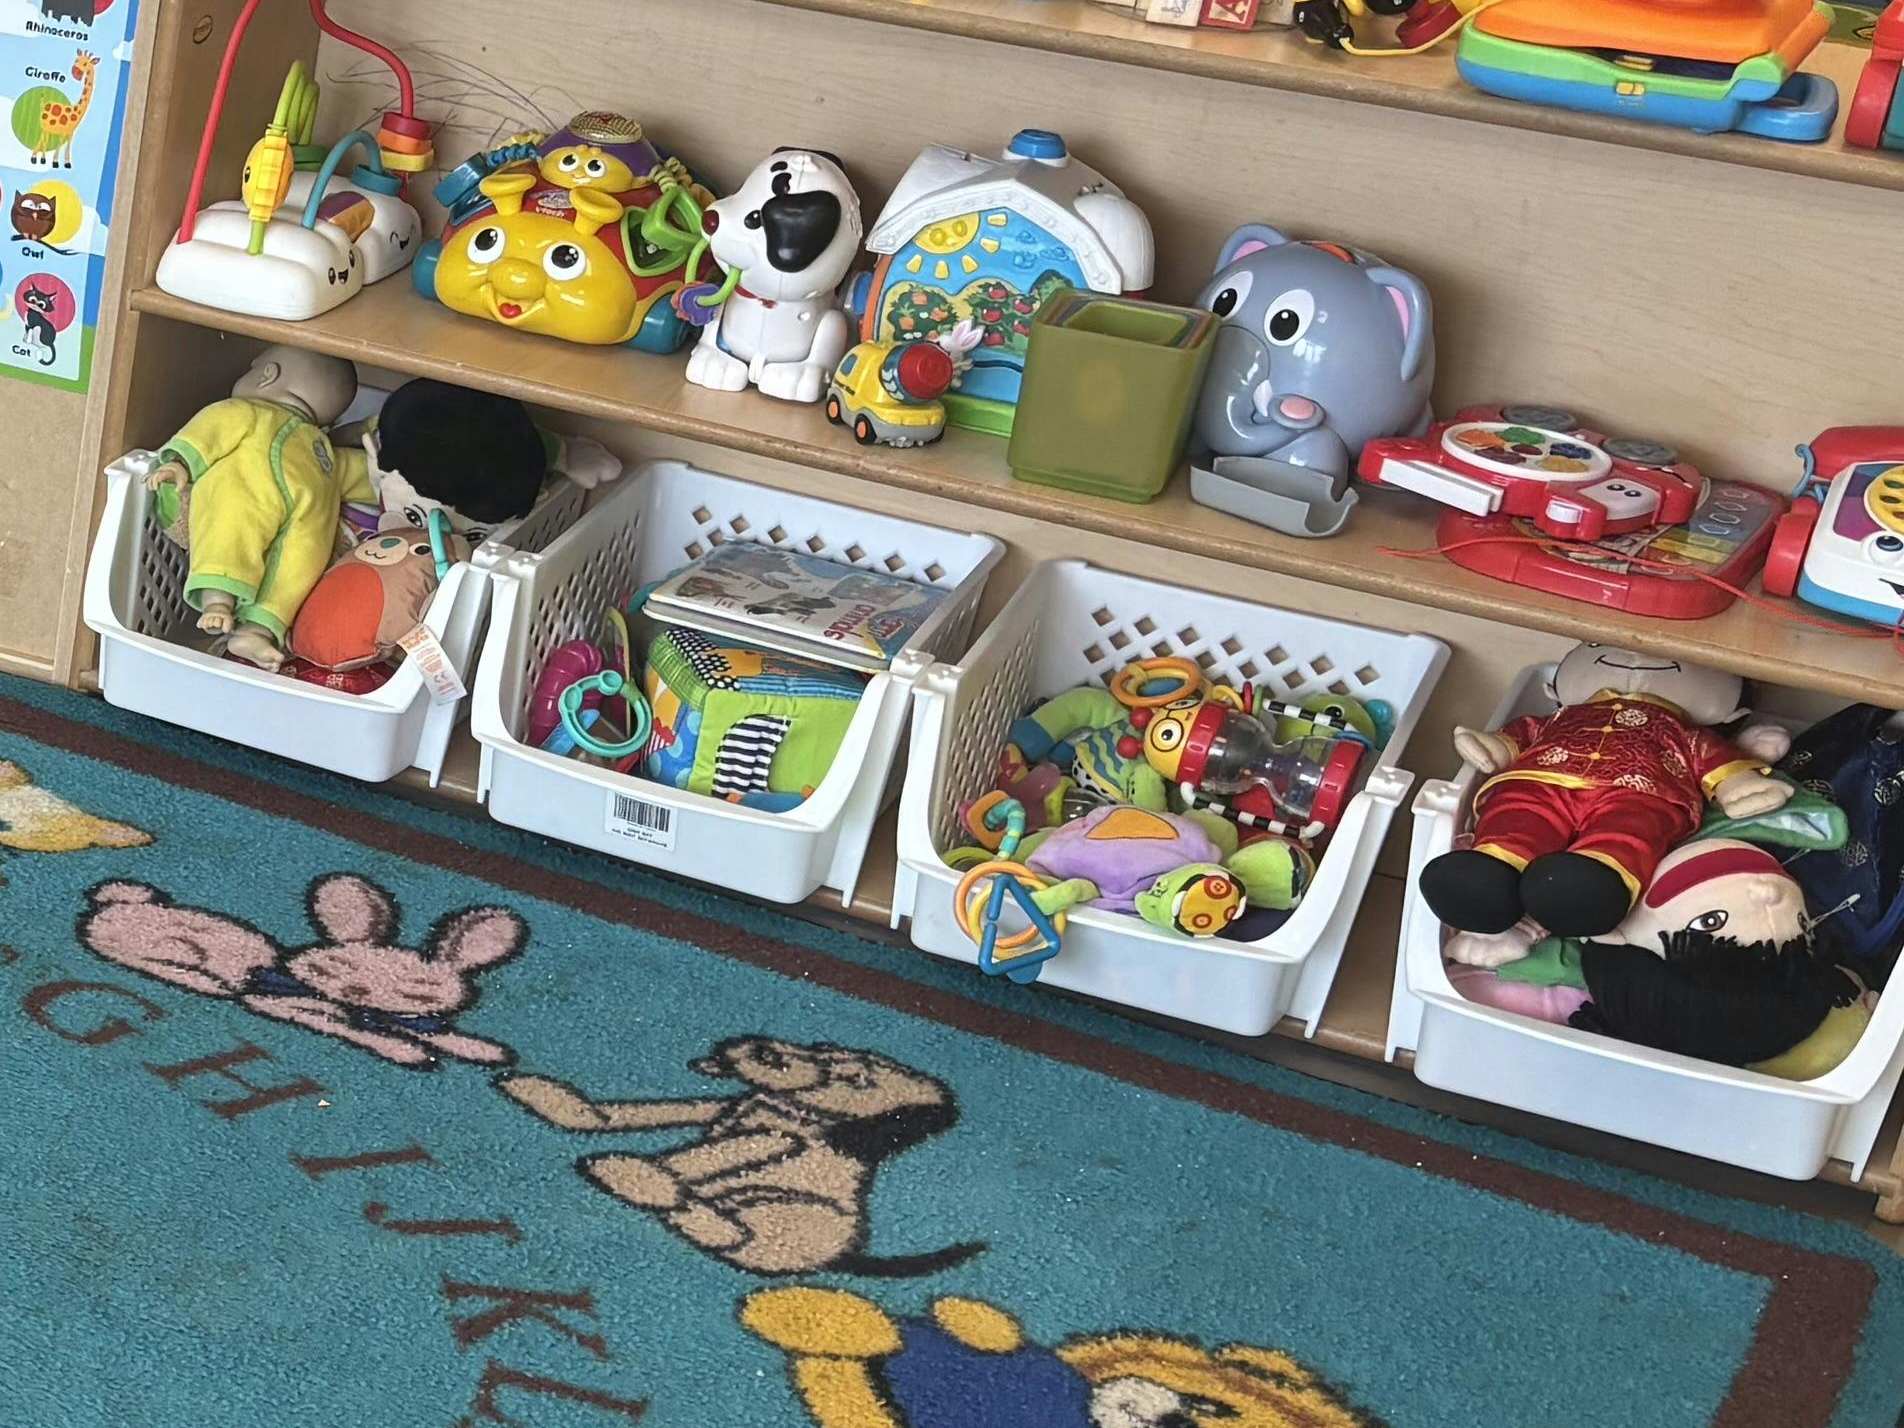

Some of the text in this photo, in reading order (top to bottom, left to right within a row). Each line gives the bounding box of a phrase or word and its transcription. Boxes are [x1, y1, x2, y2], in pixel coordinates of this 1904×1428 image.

[25, 21, 89, 41] Rhinoceros
[25, 66, 66, 83] Giraffe
[21, 247, 44, 259] Owl
[12, 345, 31, 357] Cat
[22, 979, 163, 1045] G
[143, 1041, 331, 1121] H
[290, 1144, 441, 1181] I
[441, 1276, 612, 1360] K
[477, 1359, 651, 1428] L
